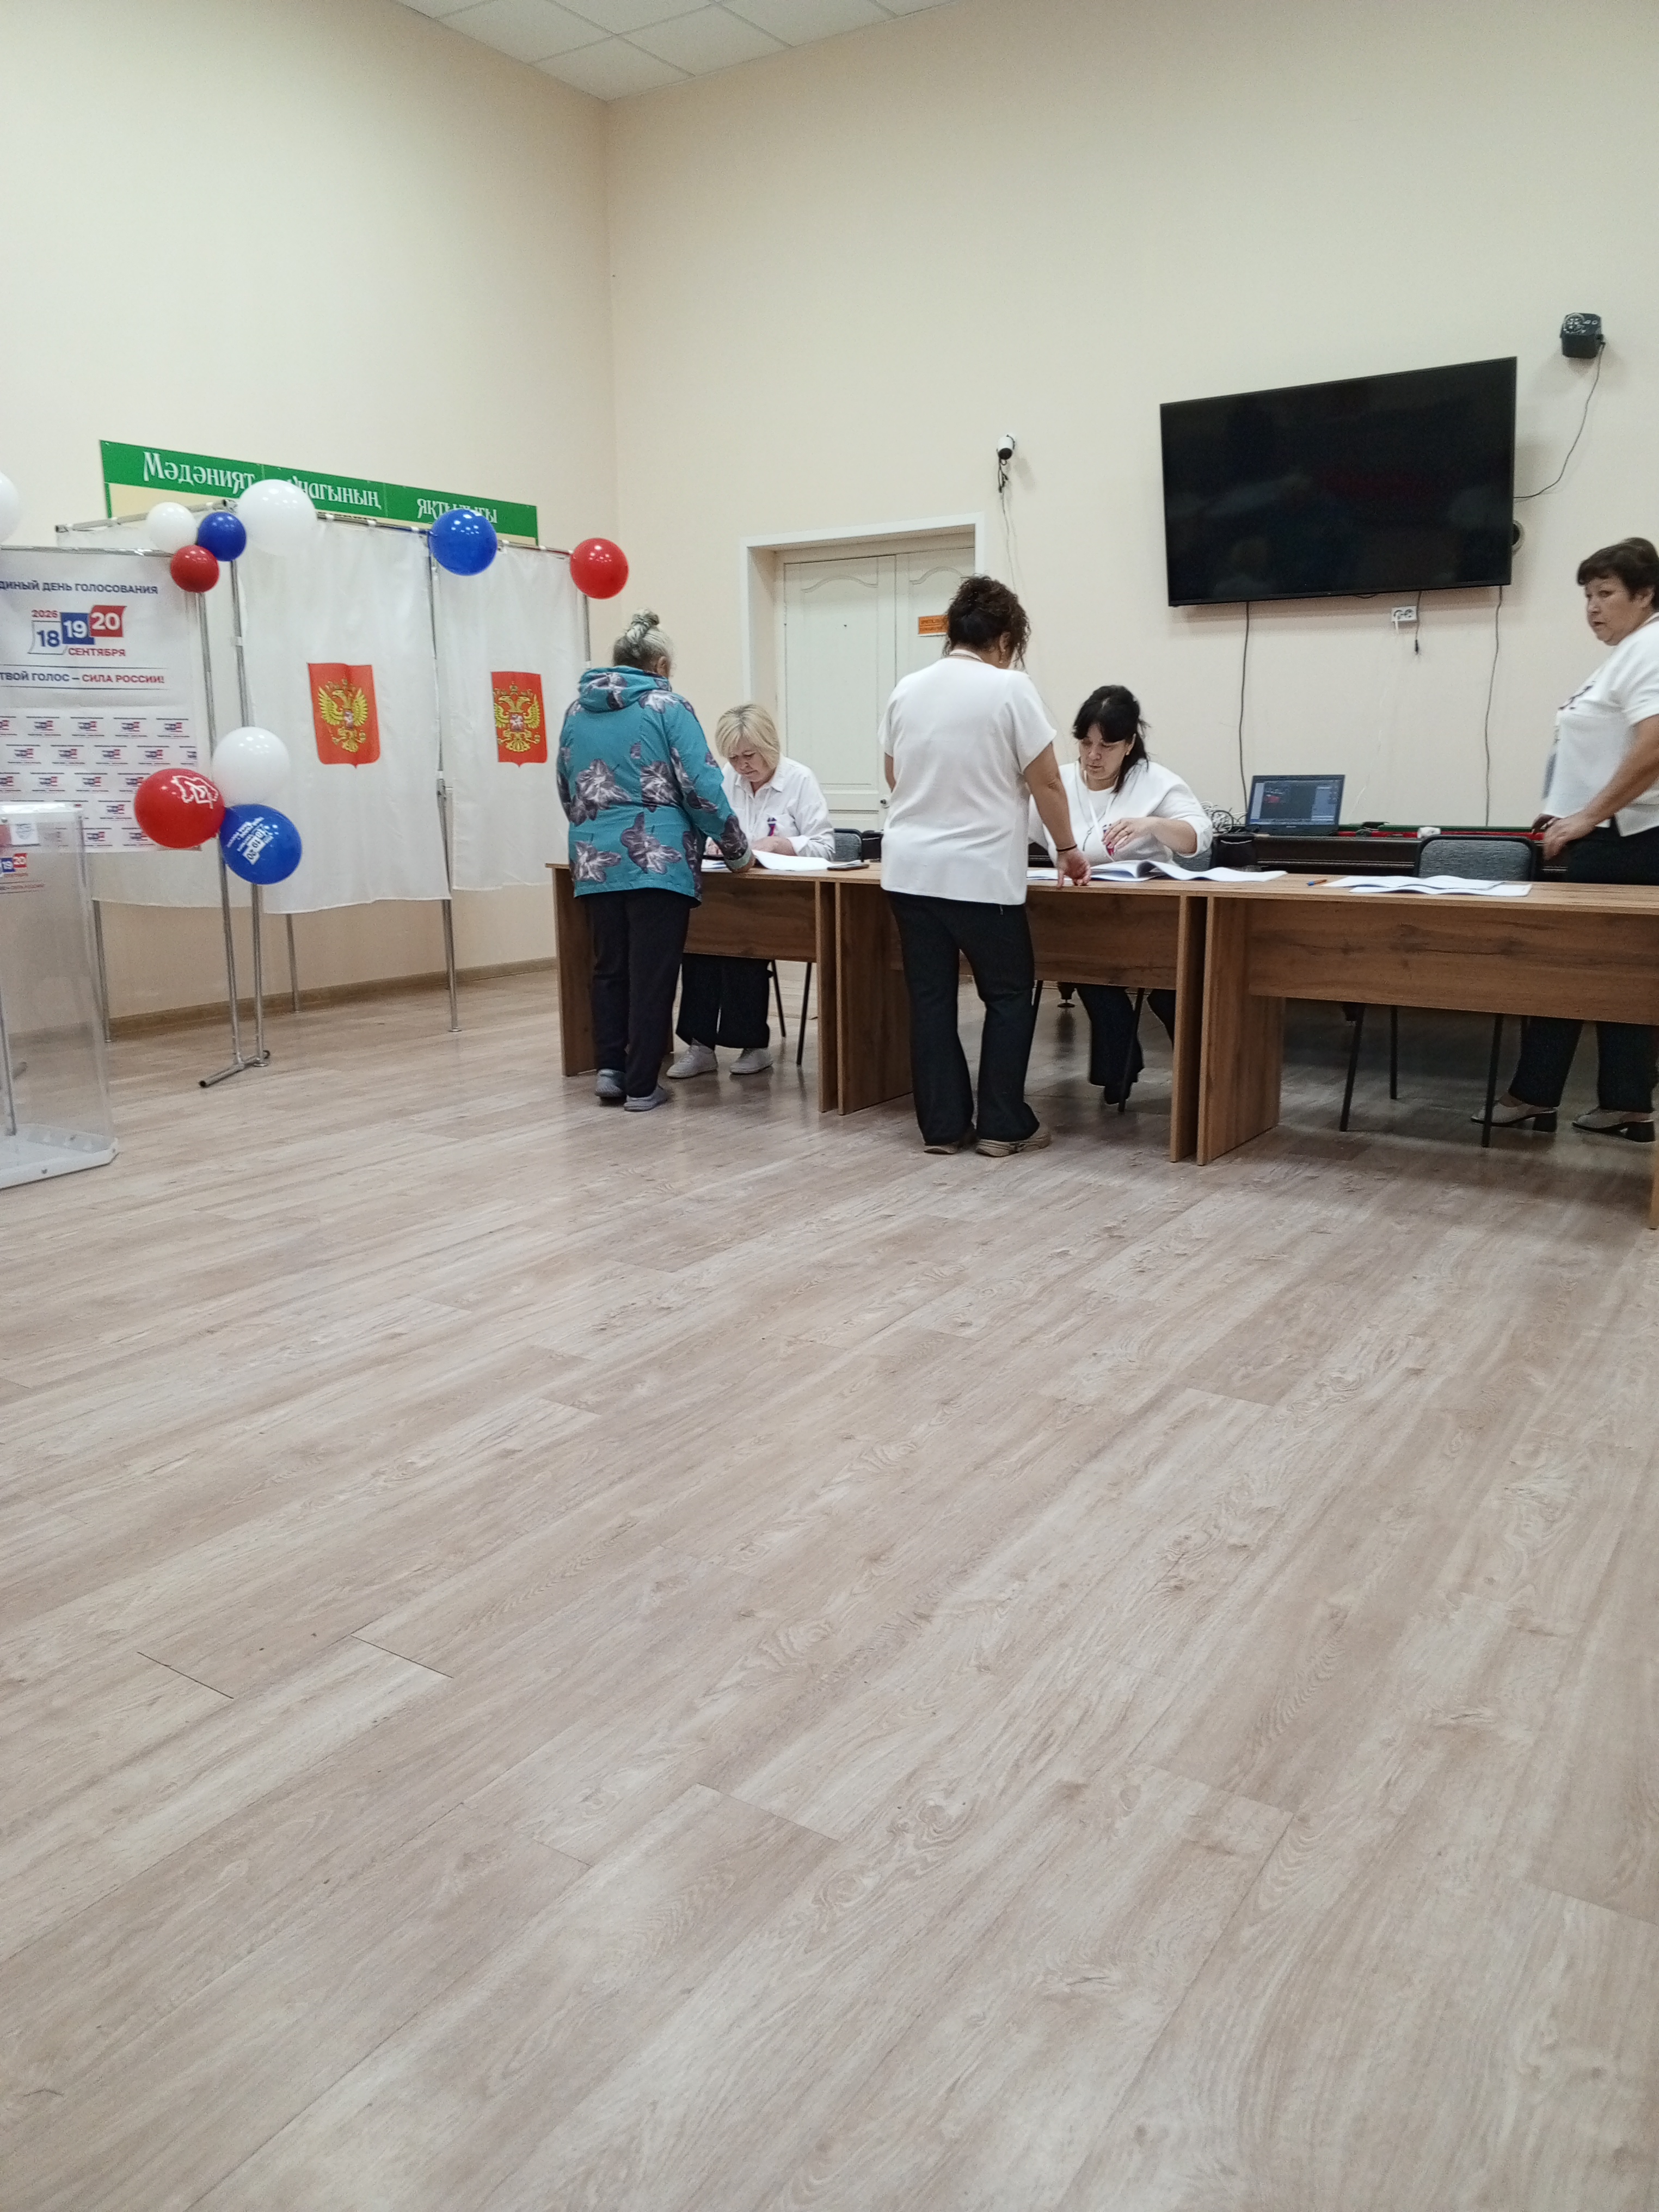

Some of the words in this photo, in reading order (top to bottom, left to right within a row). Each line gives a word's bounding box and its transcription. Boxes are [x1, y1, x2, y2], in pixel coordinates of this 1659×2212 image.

[143, 451, 255, 494] Мәдәният
[286, 475, 382, 511] чагының
[42, 582, 73, 592] ДЕНЬ
[75, 583, 159, 594] ГОЛОСОВАНИЯ
[36, 630, 60, 647] 18
[63, 620, 88, 638] 19
[91, 612, 121, 631] 20
[68, 648, 126, 656] СЕНТЯБРЯ
[0, 671, 29, 680] ТВОЙ
[32, 673, 70, 681] ГОЛОС
[82, 674, 114, 683] СИЛА
